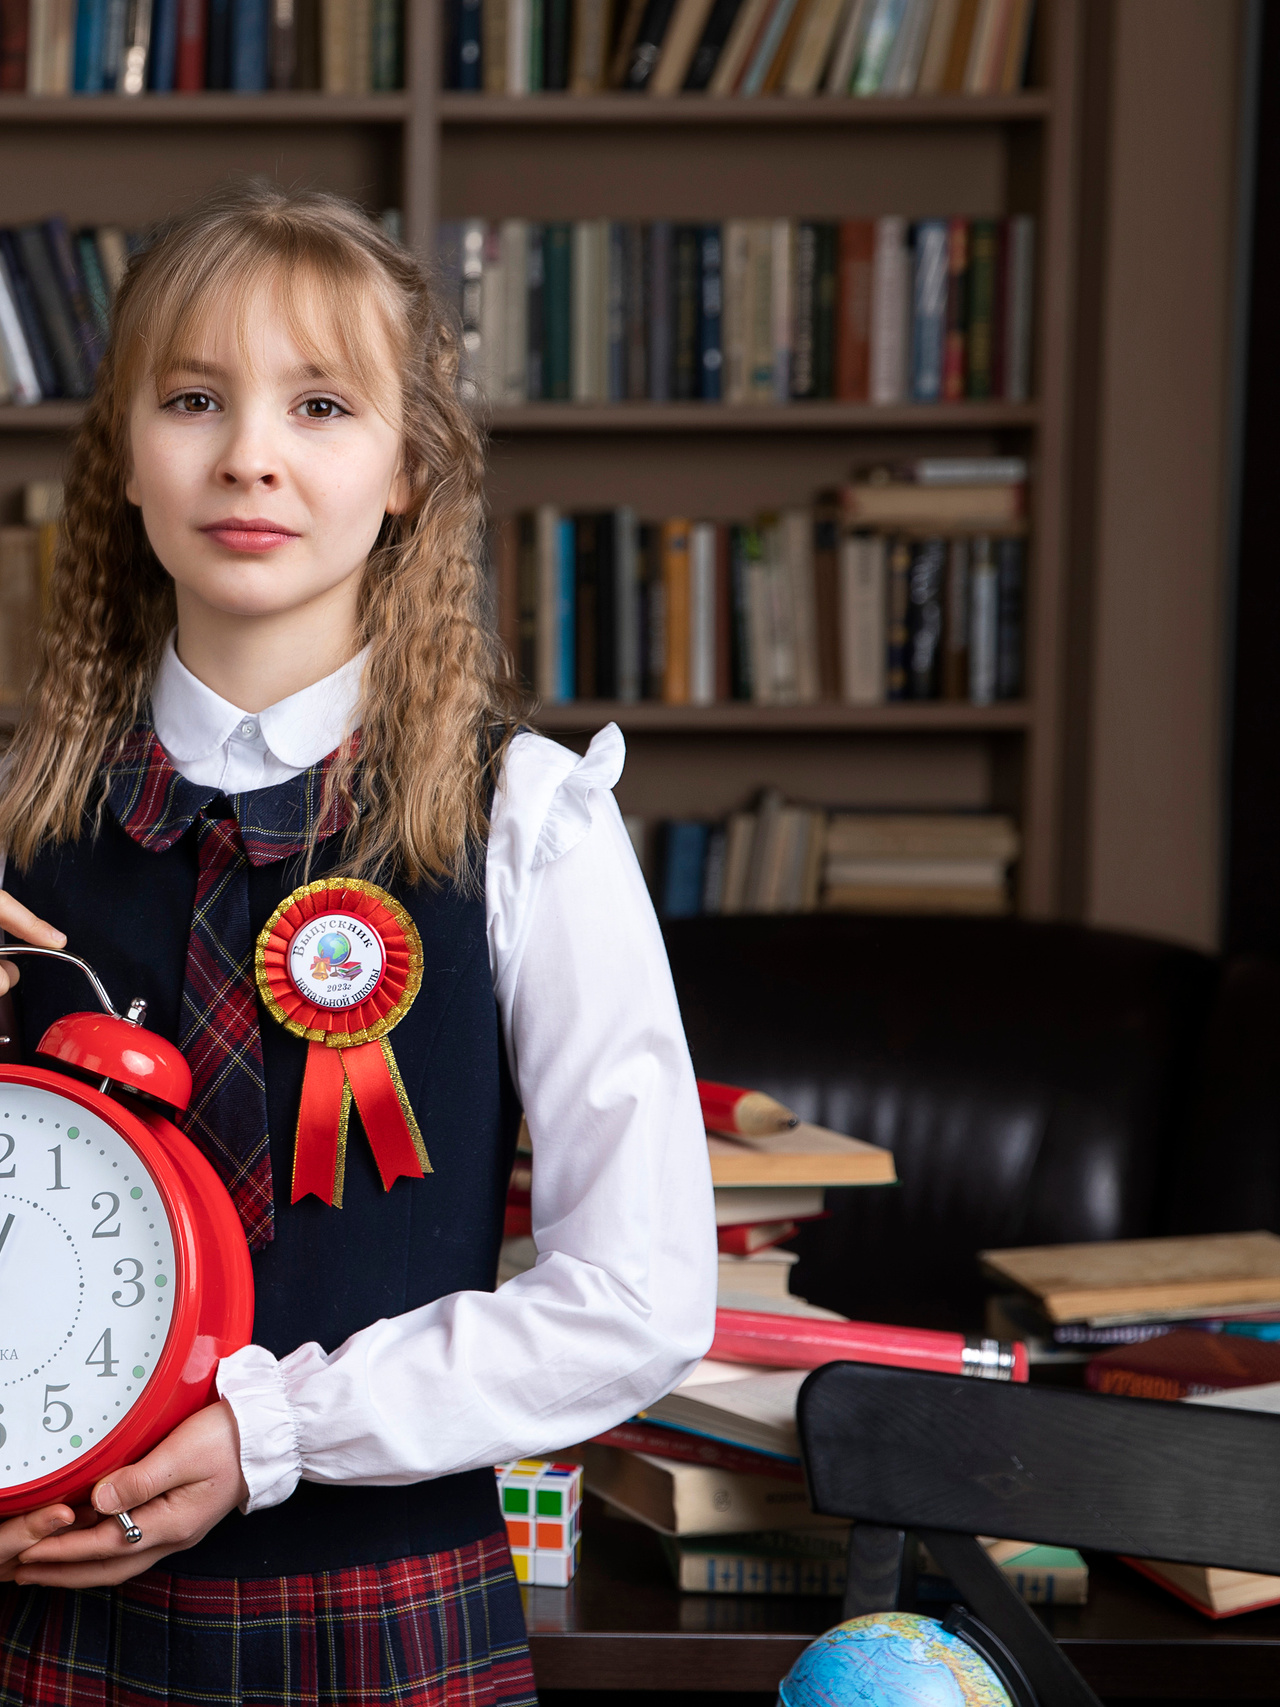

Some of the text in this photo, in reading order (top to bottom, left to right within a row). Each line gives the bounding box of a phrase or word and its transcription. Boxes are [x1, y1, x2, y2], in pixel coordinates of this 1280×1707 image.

[292, 919, 373, 957] Выпускник
[295, 968, 381, 1008] начальной школы
[46, 1144, 71, 1191] 1
[90, 1191, 121, 1239] 2
[111, 1257, 146, 1308] 3
[84, 1327, 120, 1378] 4
[42, 1383, 74, 1433] 5
